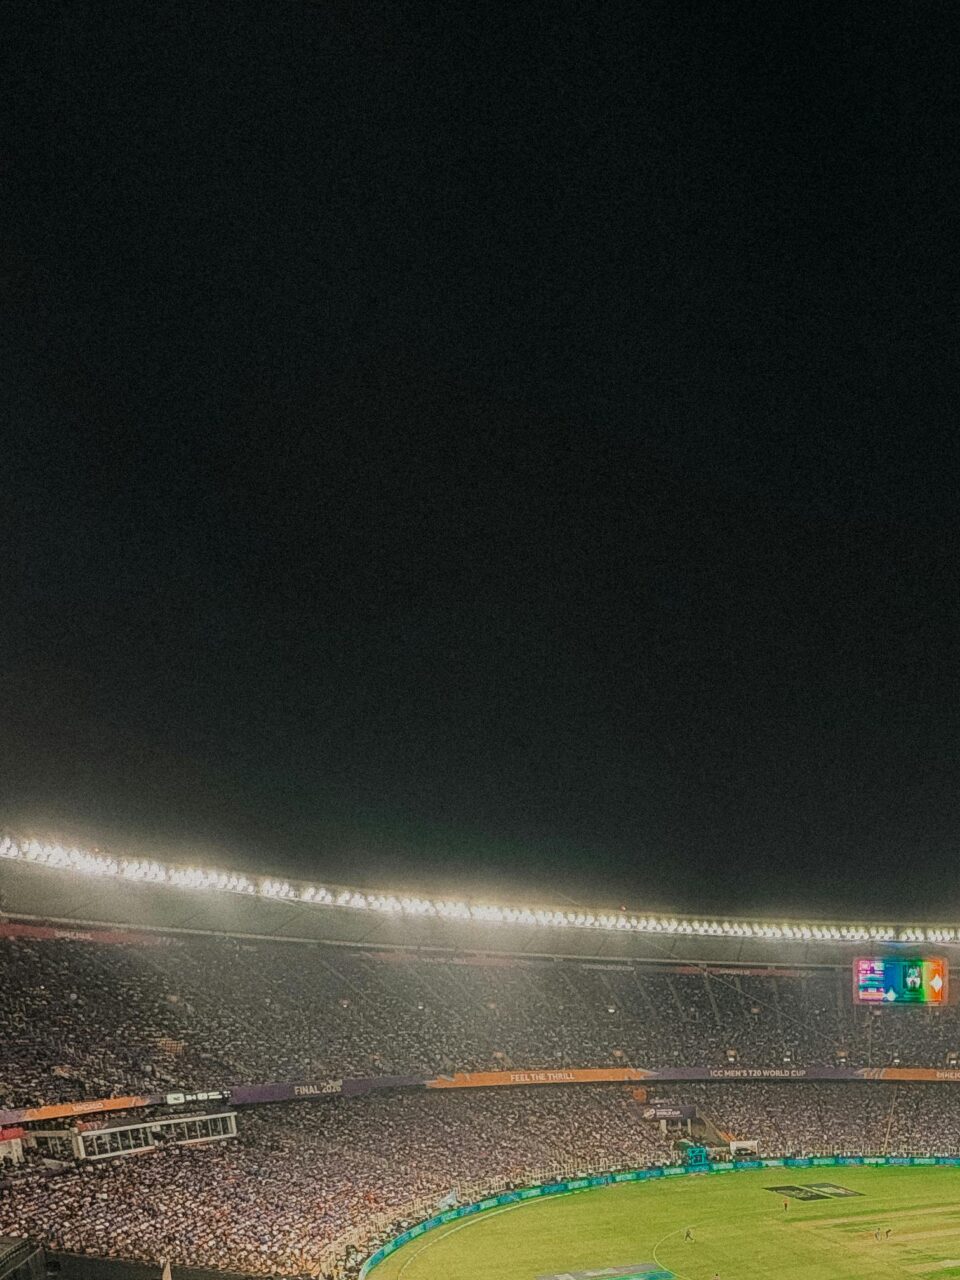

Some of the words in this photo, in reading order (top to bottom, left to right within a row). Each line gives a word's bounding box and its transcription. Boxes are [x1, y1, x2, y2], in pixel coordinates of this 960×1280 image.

[511, 1073, 530, 1081] FEEL
[530, 1073, 547, 1081] THE
[548, 1072, 575, 1081] THRILL
[294, 1085, 320, 1095] FINAL
